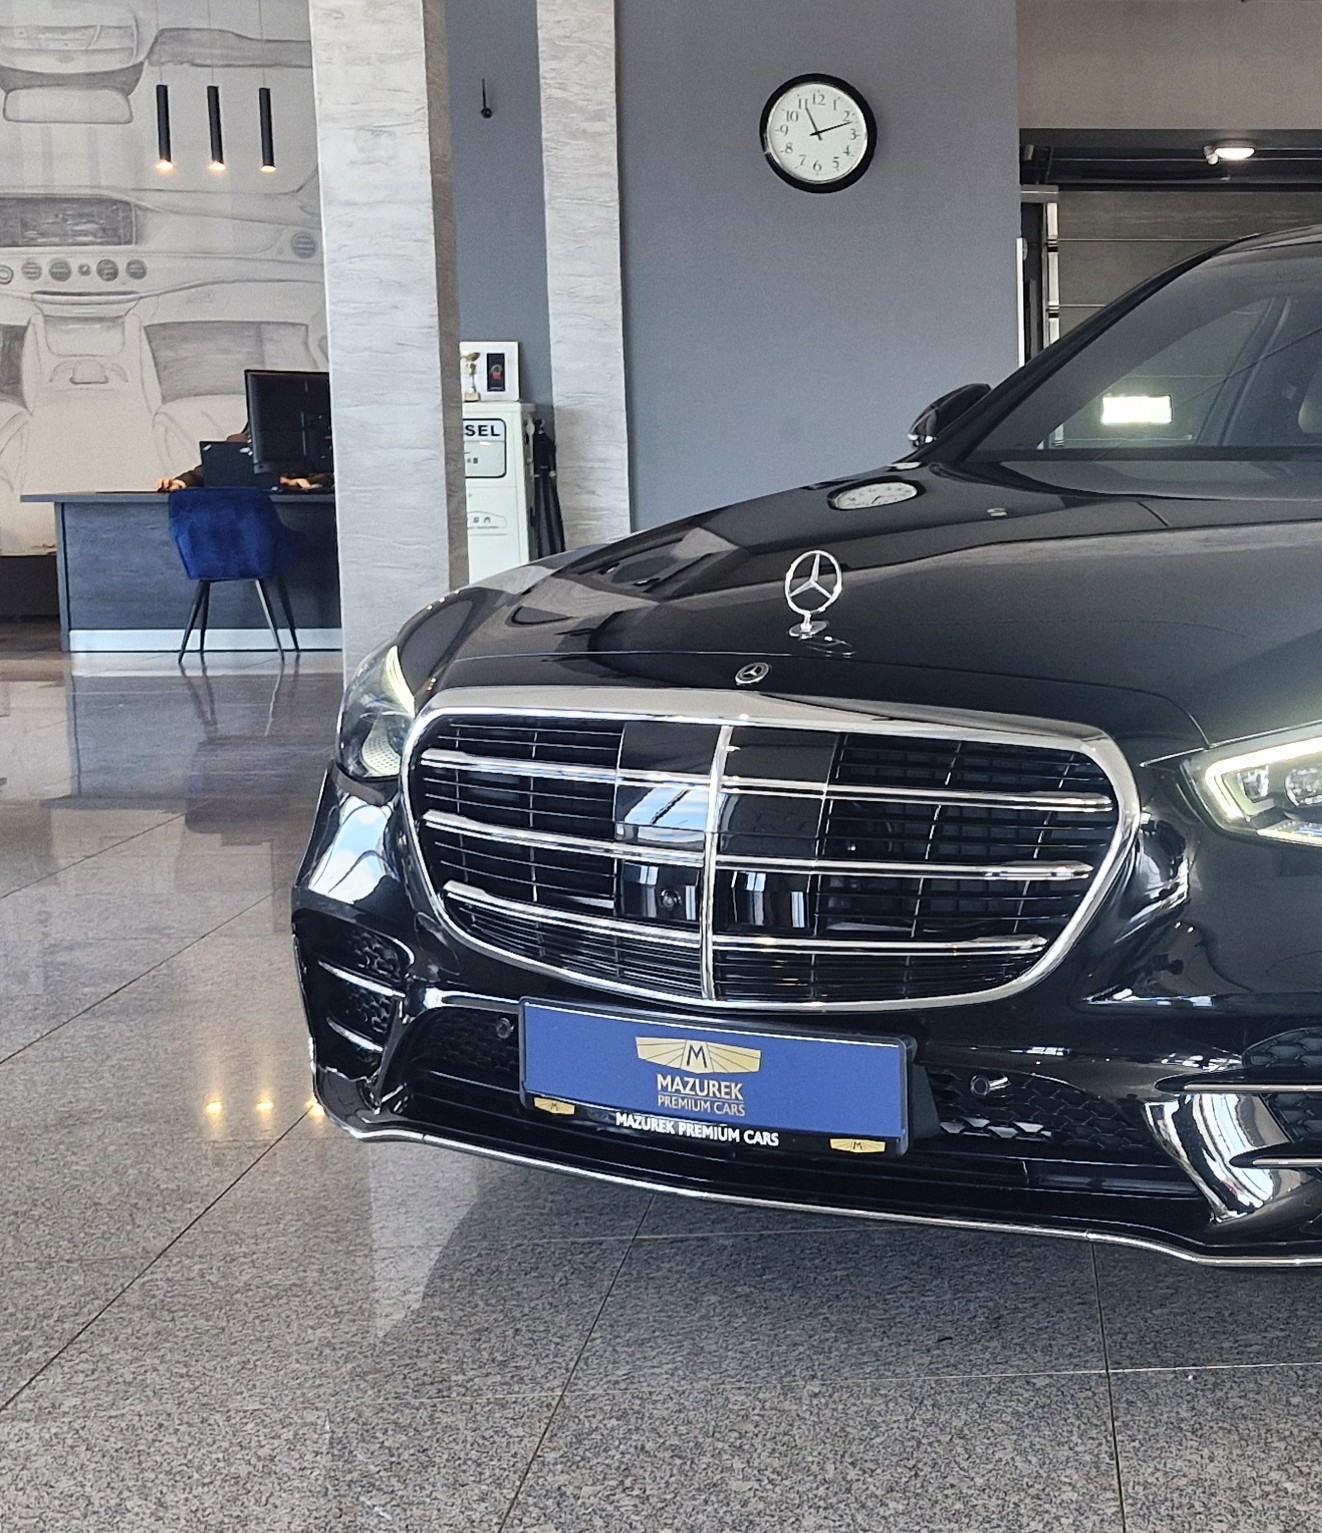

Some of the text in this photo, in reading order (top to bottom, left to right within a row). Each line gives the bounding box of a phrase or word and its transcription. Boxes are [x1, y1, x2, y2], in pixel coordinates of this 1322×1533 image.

[812, 93, 826, 106] 12
[786, 110, 799, 122] 10
[843, 110, 851, 121] 2
[780, 125, 788, 136] 9
[850, 128, 857, 140] 3
[785, 142, 793, 154] 8
[843, 145, 850, 156] 4
[800, 154, 807, 166] 7
[812, 159, 822, 172] 6
[832, 156, 840, 171] 5
[465, 424, 501, 437] SEL
[686, 1044, 708, 1068] M
[656, 1073, 743, 1100] MAZUREK
[657, 1094, 746, 1117] PREMIUM CARS
[615, 1111, 779, 1146] MAZUREK PREMIUM CARS
[852, 1141, 863, 1150] M
